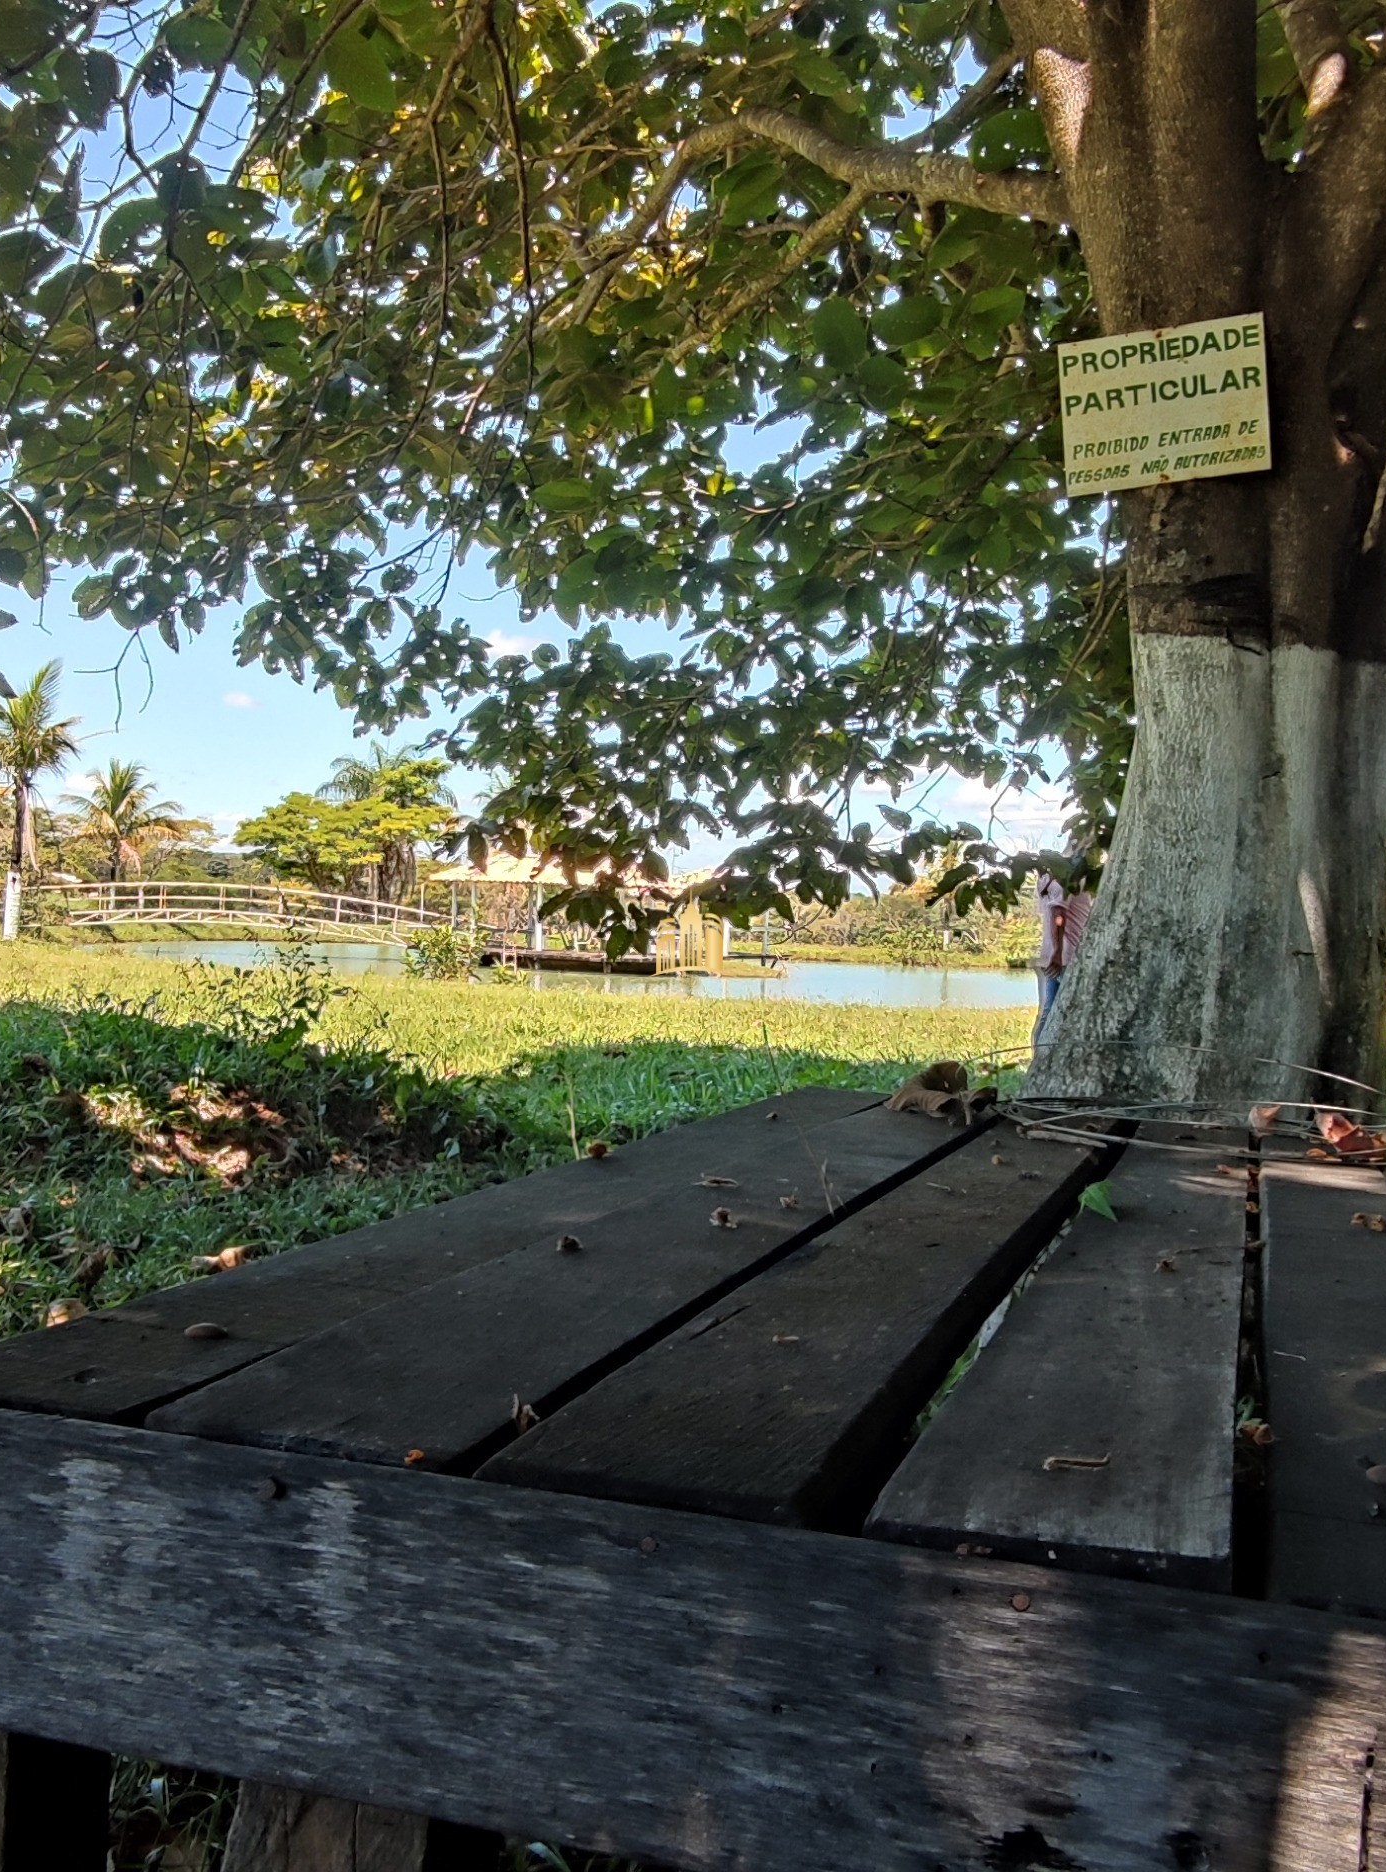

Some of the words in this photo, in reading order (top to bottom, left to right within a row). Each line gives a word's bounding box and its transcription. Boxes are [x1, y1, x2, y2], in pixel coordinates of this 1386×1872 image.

[1062, 324, 1260, 377] PROPRIEDADE
[1065, 366, 1261, 417] PARTICULAR
[1073, 436, 1149, 460] PROIBIDO
[1158, 423, 1231, 447] ENTRADA
[1238, 419, 1259, 436] DE
[1068, 464, 1130, 486] PESSOAS
[1173, 445, 1266, 470] AUTORIZADAS
